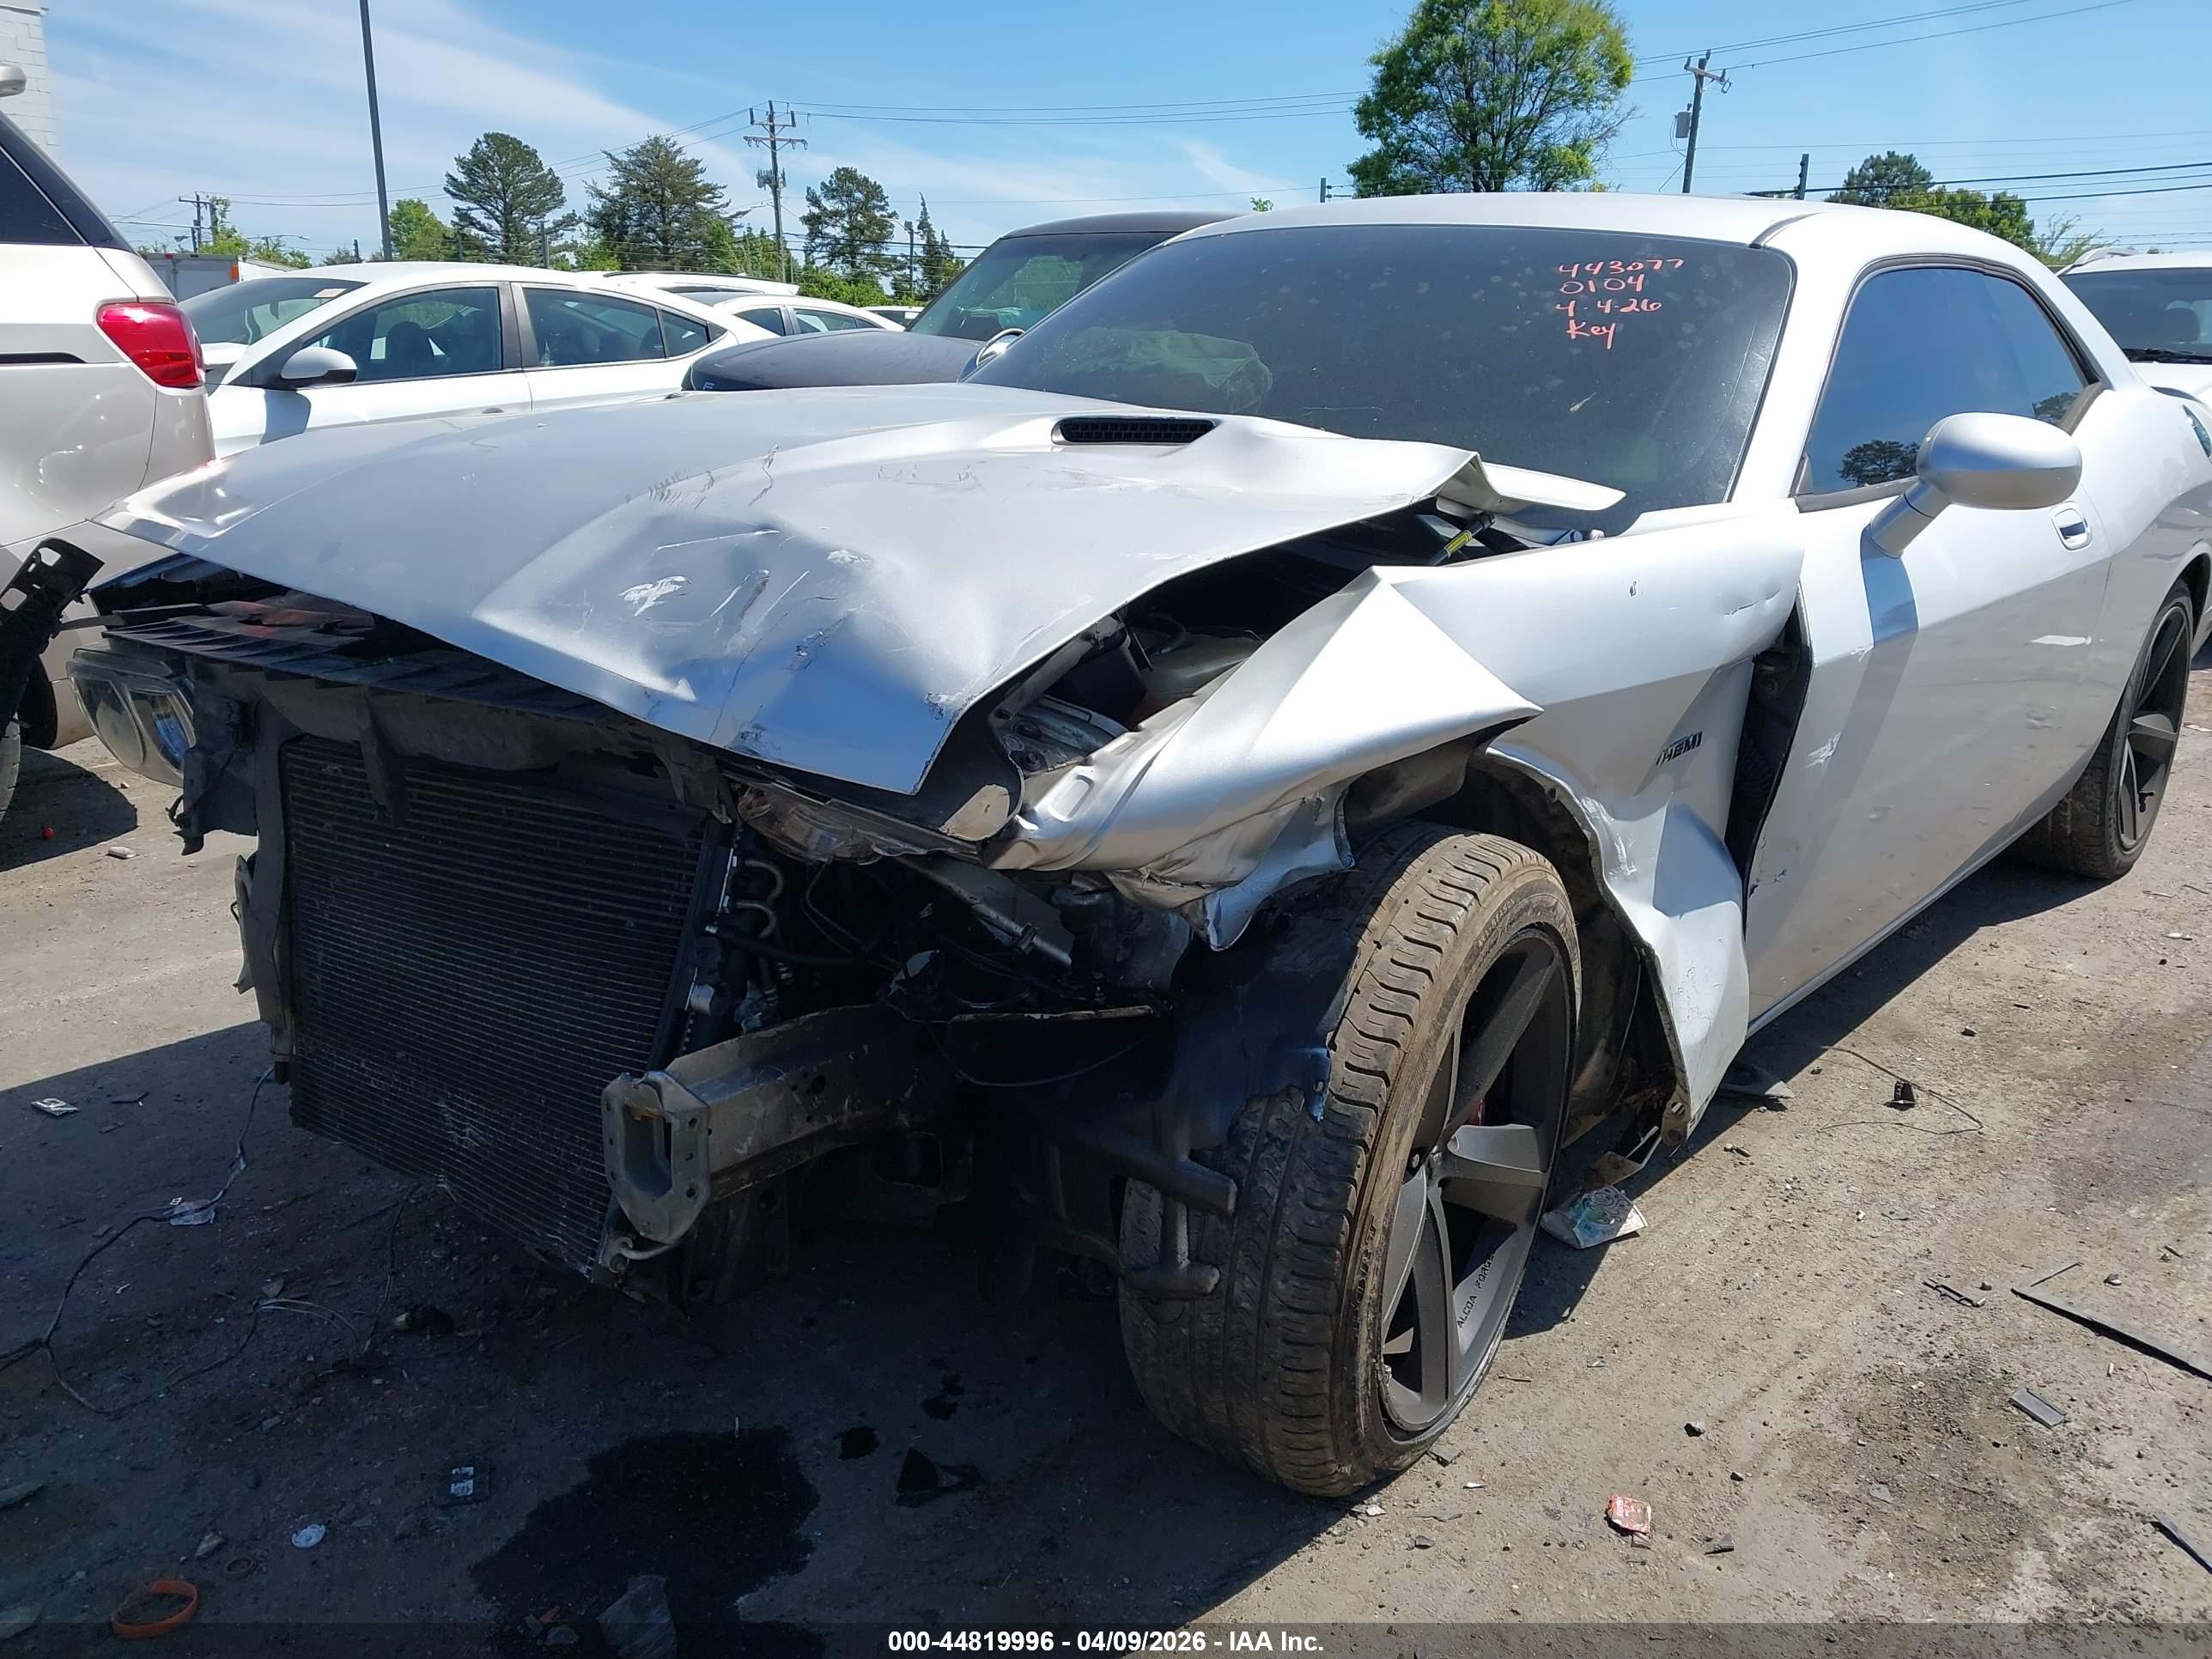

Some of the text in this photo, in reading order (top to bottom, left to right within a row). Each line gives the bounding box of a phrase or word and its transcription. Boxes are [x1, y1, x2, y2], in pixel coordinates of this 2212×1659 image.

[1559, 258, 1685, 278] 443077
[1559, 274, 1644, 295] 0104
[1566, 319, 1616, 350] Key
[1655, 731, 1703, 766] HEMI
